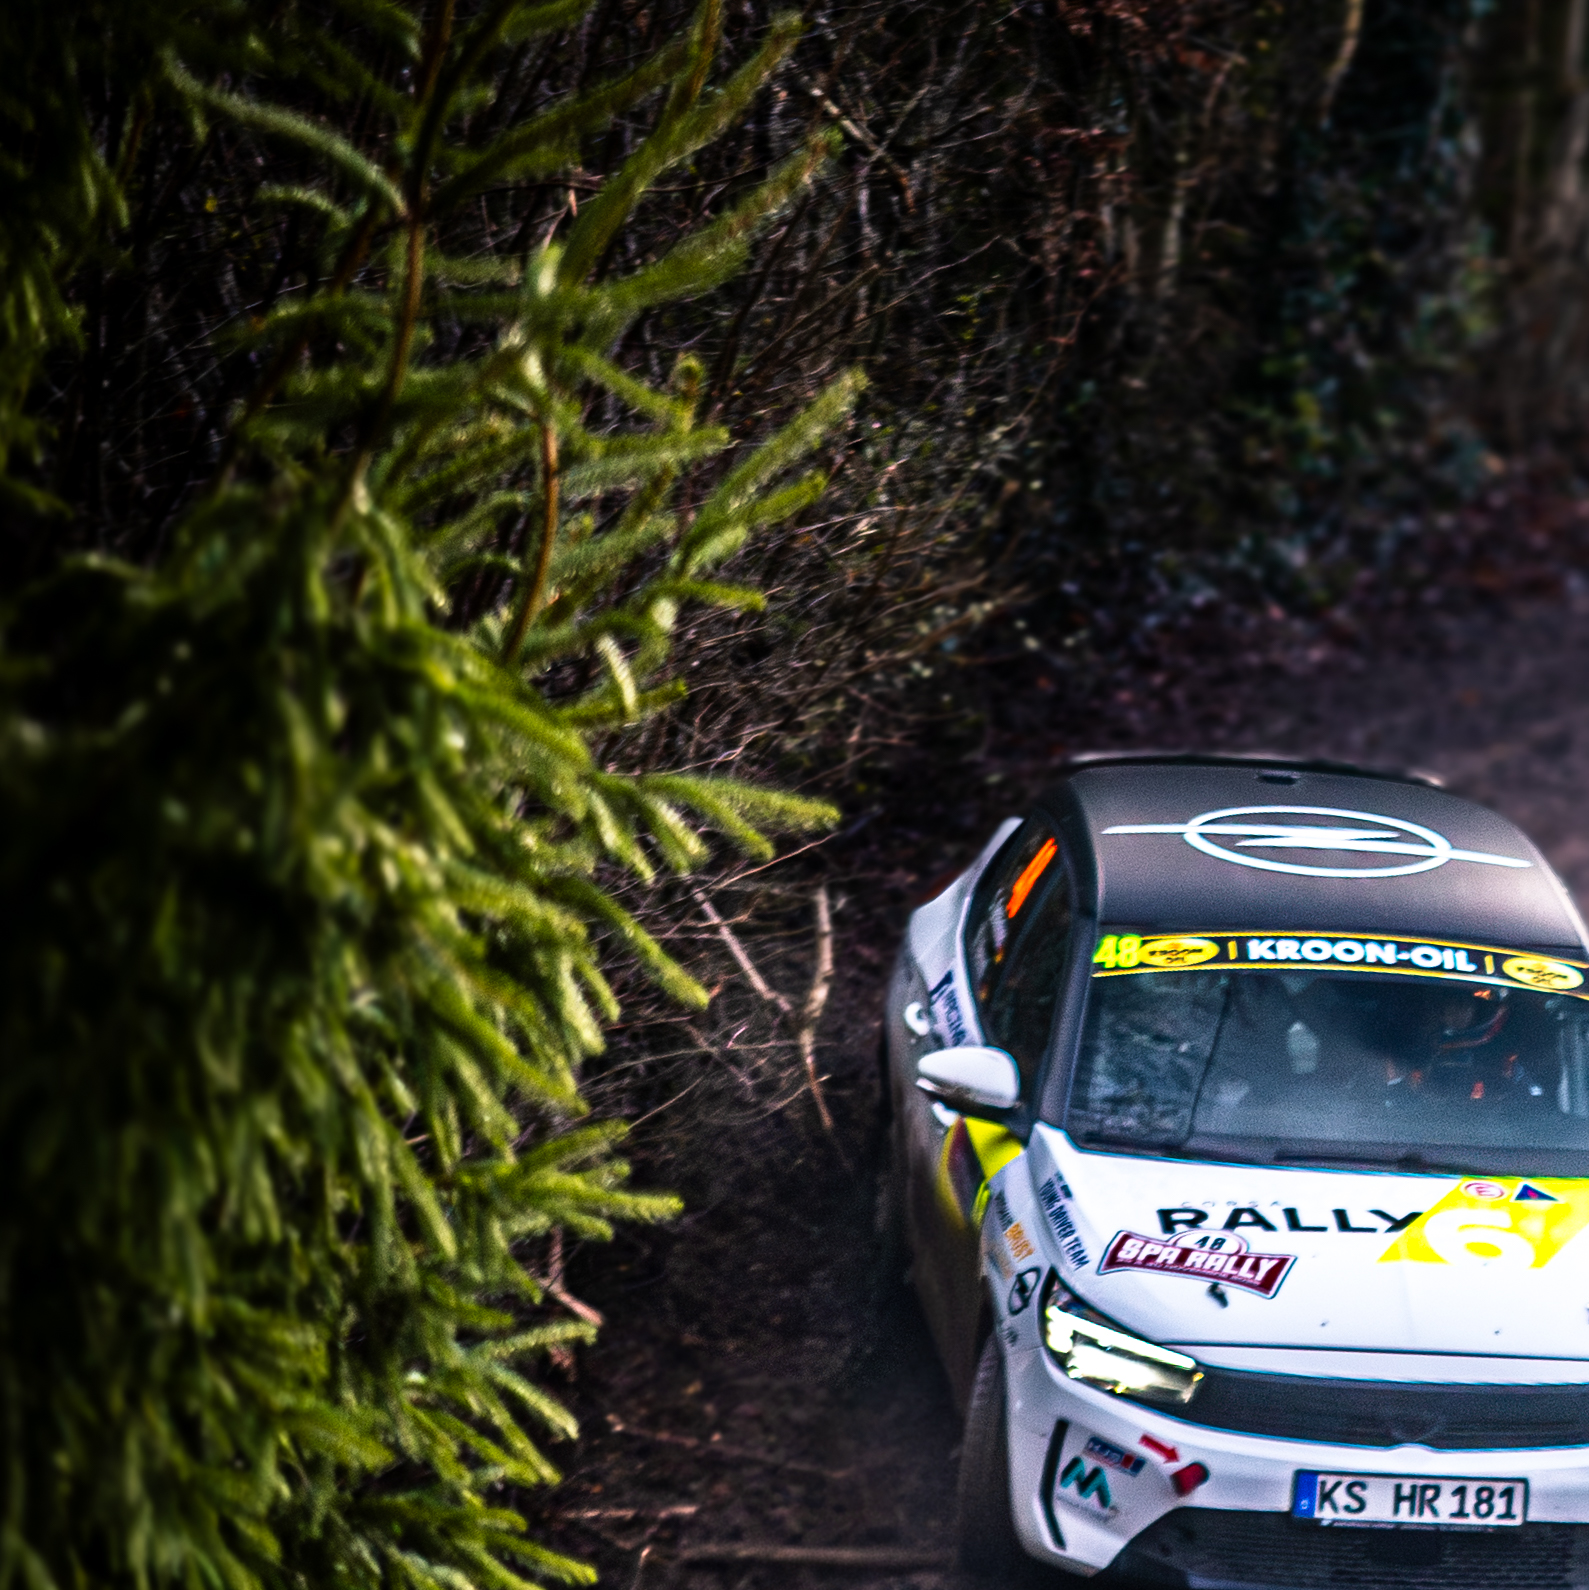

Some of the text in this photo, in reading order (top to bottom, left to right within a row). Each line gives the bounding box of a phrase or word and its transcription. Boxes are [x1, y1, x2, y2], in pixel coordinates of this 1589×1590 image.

[1093, 934, 1142, 968] 48
[1247, 938, 1478, 973] KROON-OIL
[1049, 1204, 1077, 1242] DRIVER
[1157, 1207, 1425, 1234] RALLY
[1062, 1236, 1092, 1272] TEAM
[1116, 1238, 1183, 1265] SPA
[1184, 1251, 1280, 1282] RALLY
[1195, 1235, 1227, 1251] 48
[1318, 1480, 1518, 1520] KS HR 181
